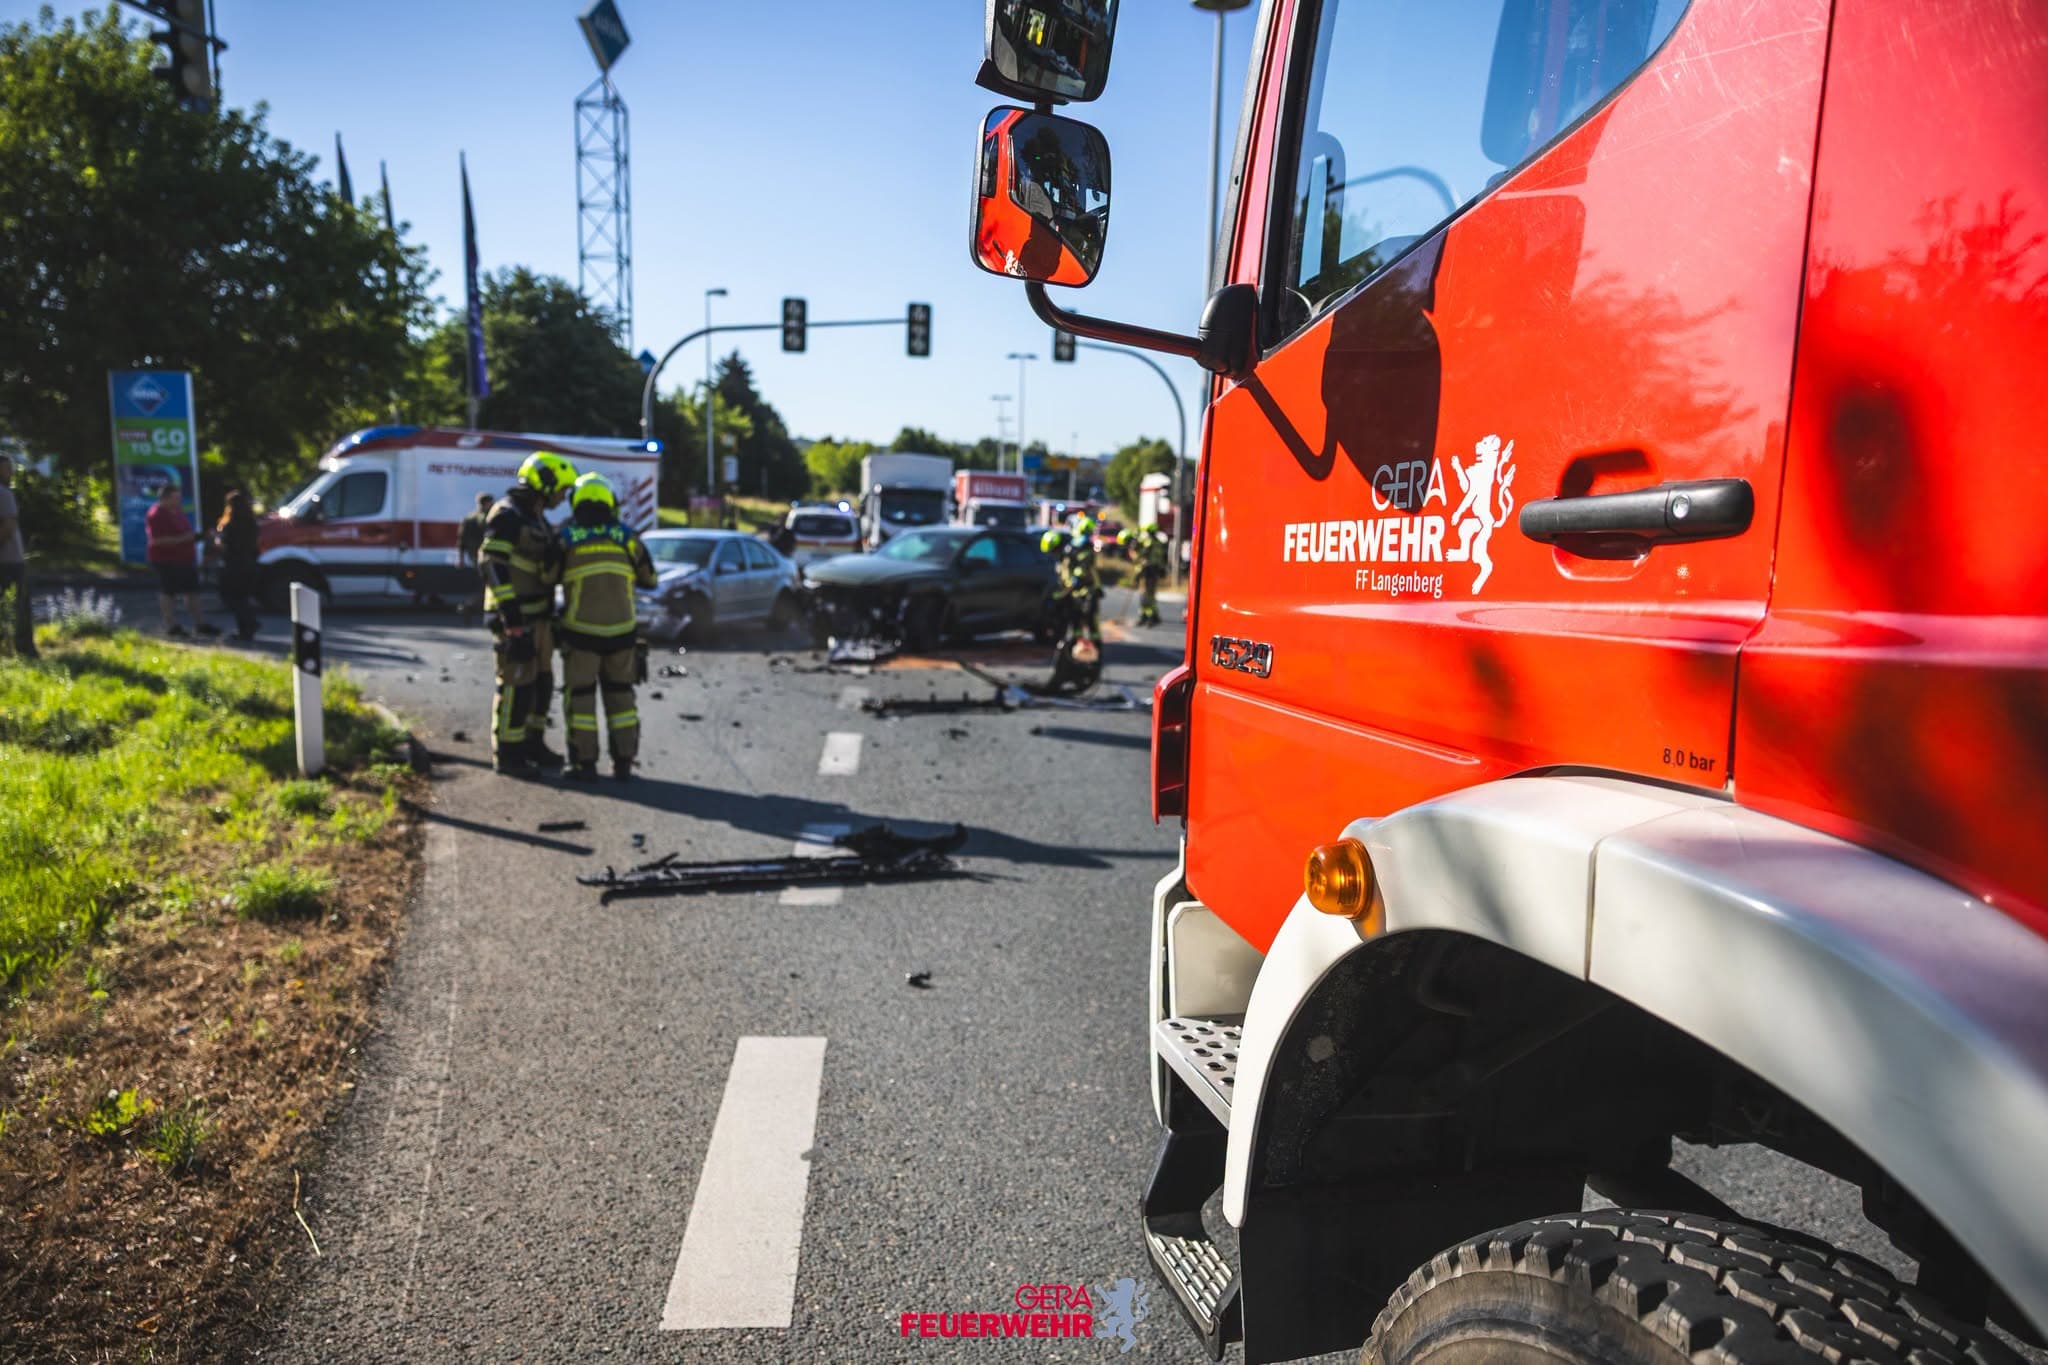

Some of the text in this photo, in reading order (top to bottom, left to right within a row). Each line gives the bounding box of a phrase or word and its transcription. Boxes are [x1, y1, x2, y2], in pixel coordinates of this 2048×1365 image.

[152, 428, 186, 447] GO
[1371, 457, 1448, 512] GERA
[1283, 515, 1445, 563] FEUERWEHR
[1355, 569, 1443, 599] FF Langenberg
[1211, 634, 1273, 678] 1529
[1689, 751, 1716, 772] bar
